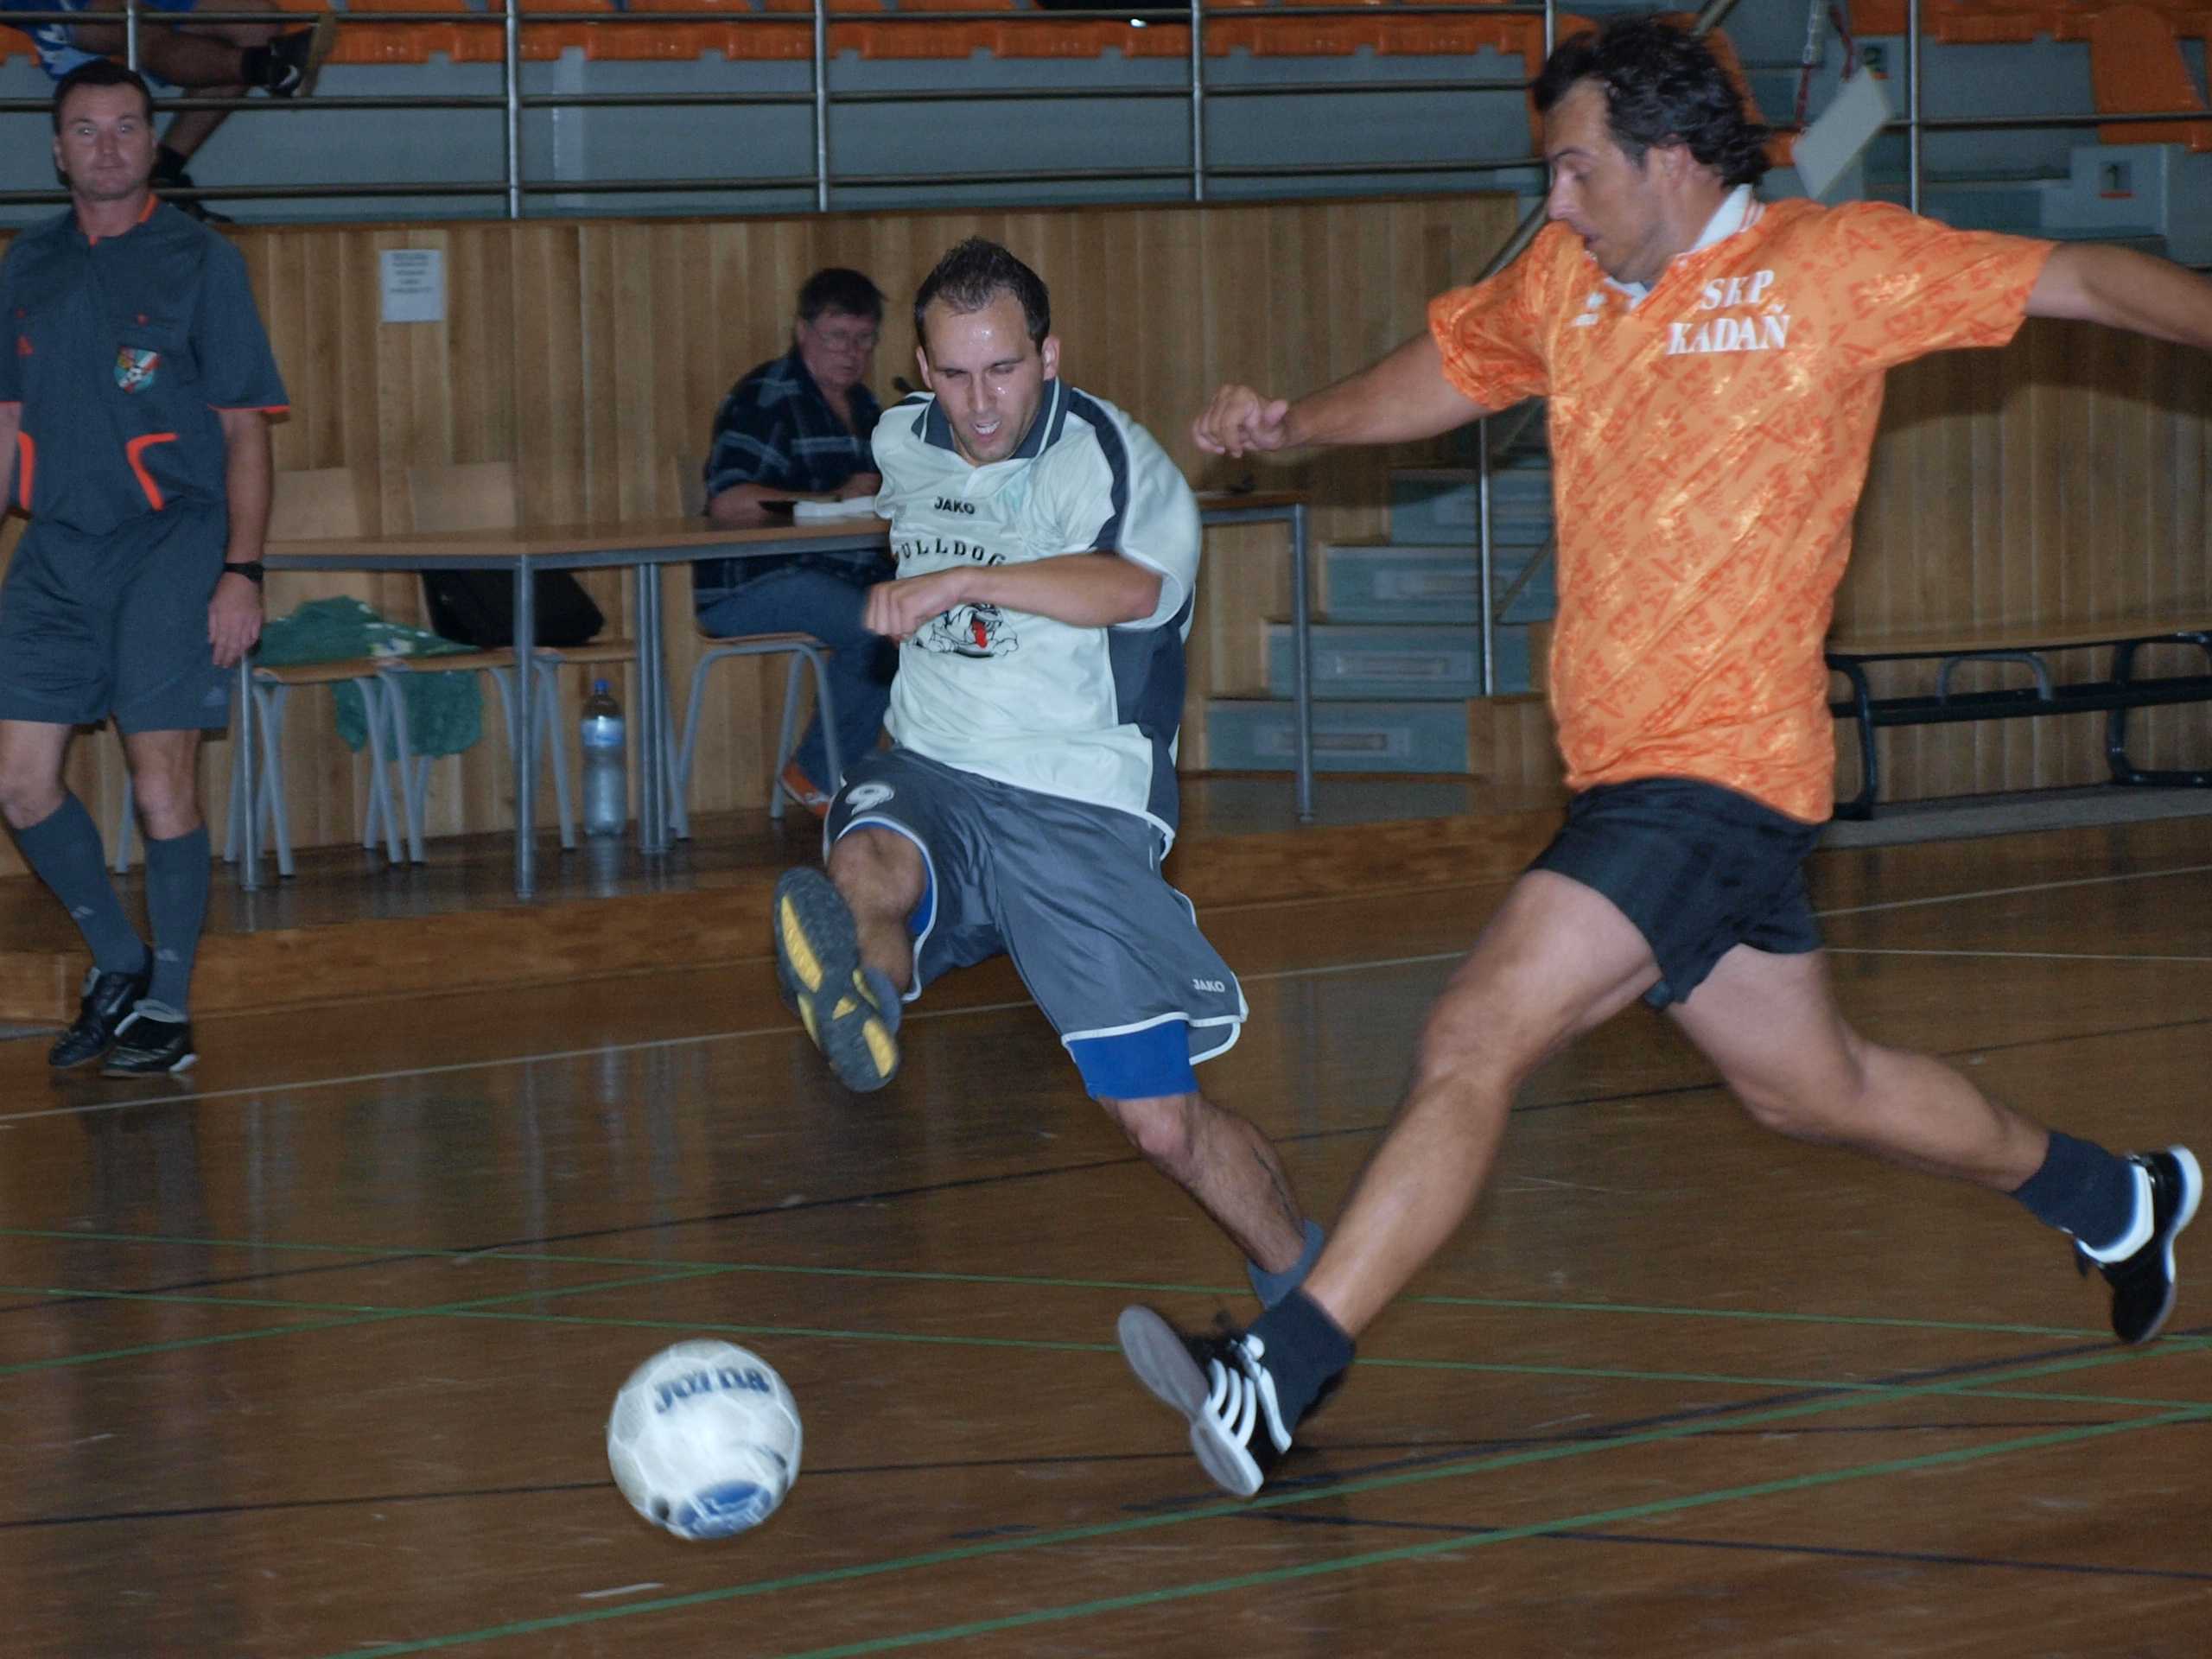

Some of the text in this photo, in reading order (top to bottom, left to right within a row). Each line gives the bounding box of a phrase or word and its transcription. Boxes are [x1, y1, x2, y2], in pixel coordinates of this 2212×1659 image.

[1700, 270, 1775, 310] SKP
[1667, 304, 1790, 355] KADAŇ
[934, 497, 976, 515] JAKO
[896, 537, 1007, 567] ULLDOG
[1193, 978, 1225, 993] JAKO
